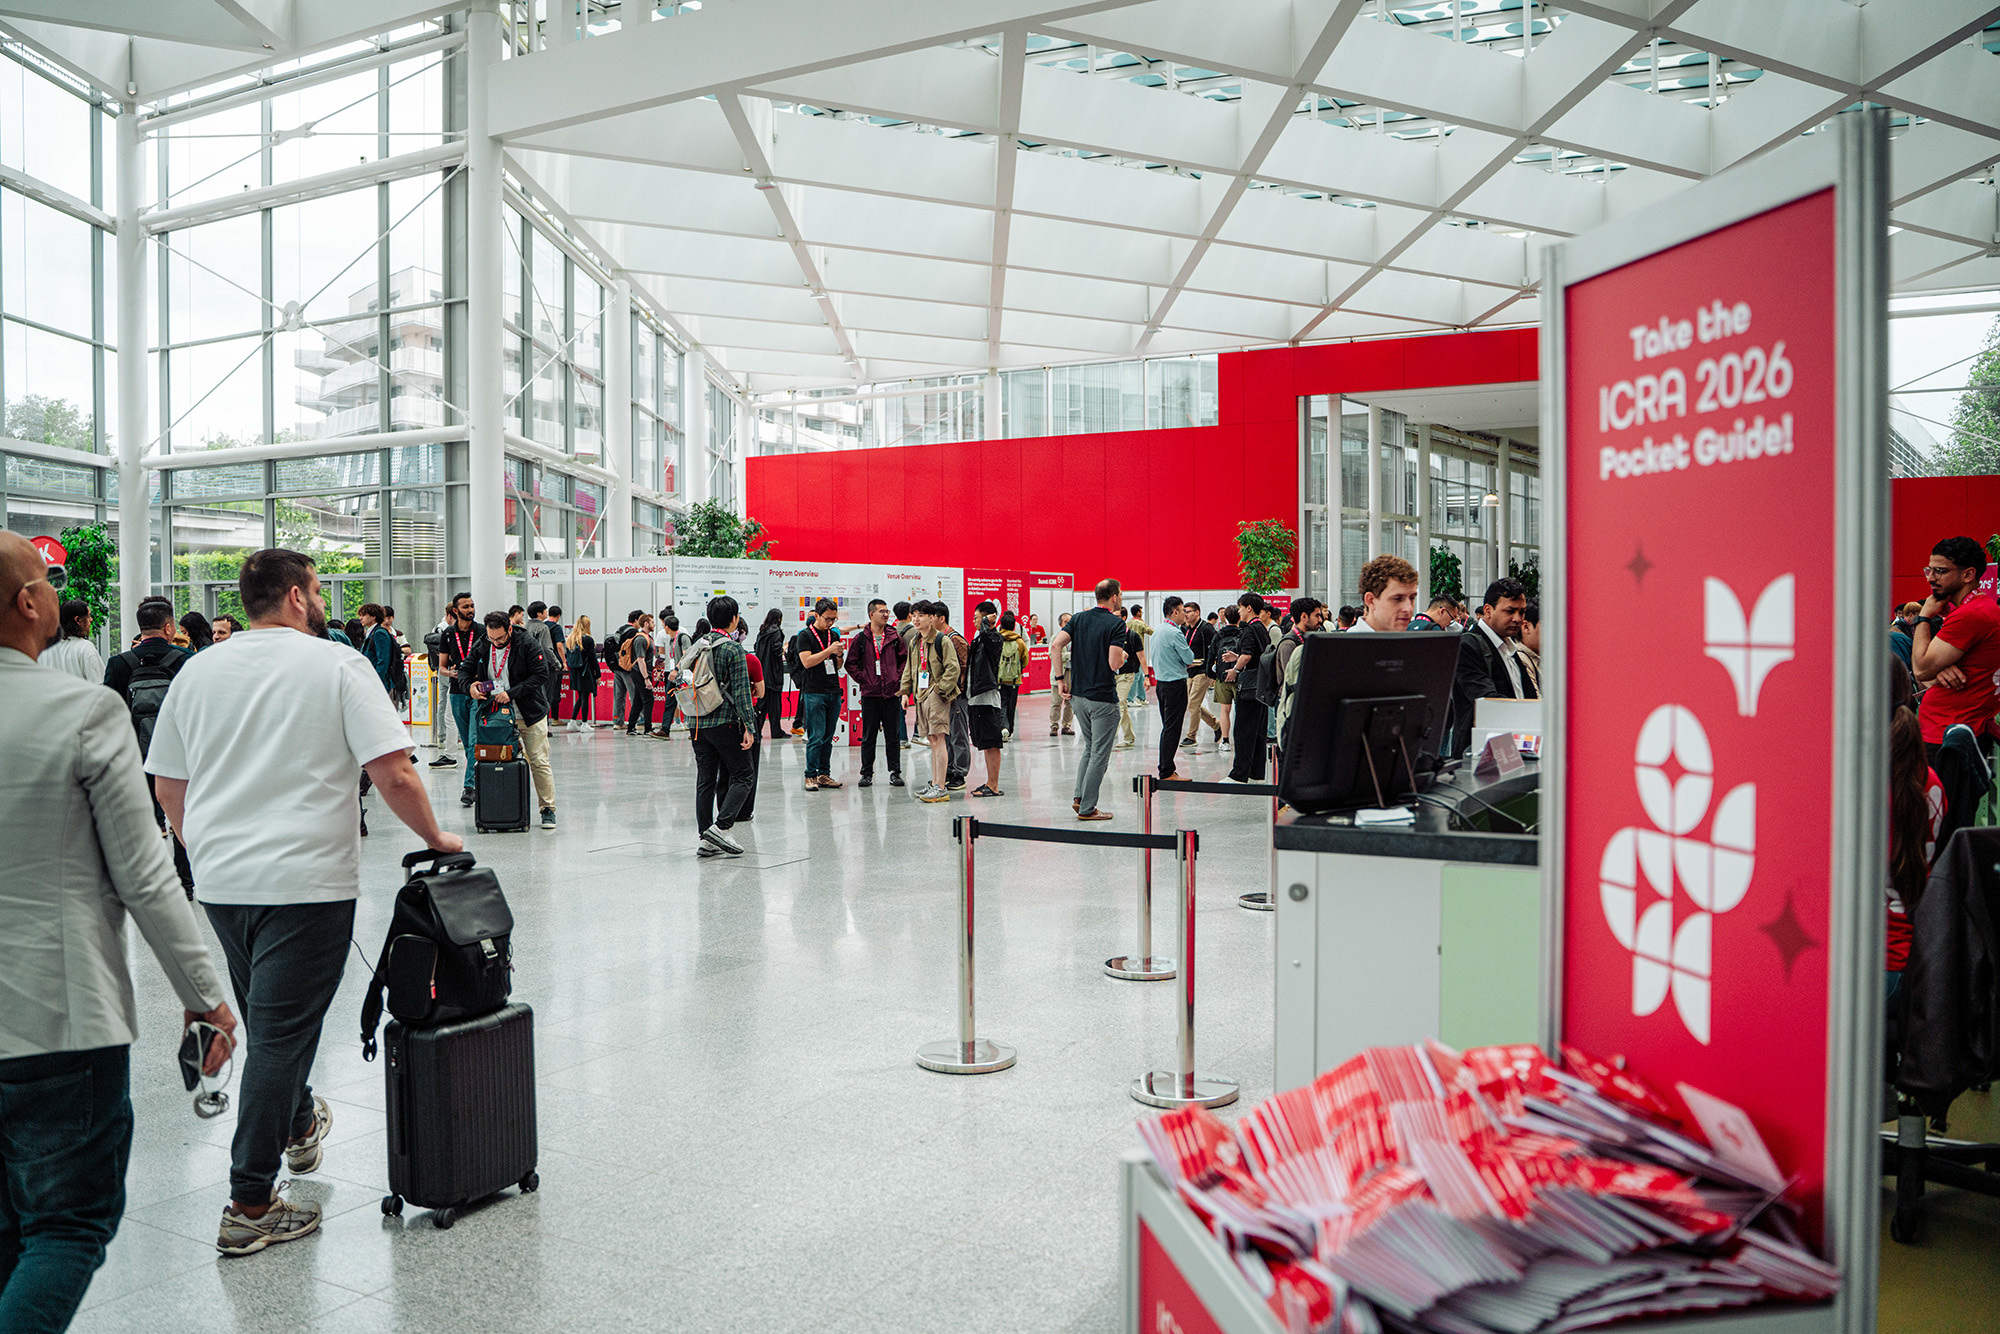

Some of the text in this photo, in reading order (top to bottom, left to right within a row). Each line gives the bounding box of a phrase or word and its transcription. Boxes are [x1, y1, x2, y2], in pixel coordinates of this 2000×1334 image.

[1629, 299, 1752, 362] Take the
[1599, 340, 1794, 433] ICRA 2026
[1600, 412, 1794, 481] Pocket Guide!
[625, 565, 667, 574] Distribution
[769, 569, 793, 578] Program
